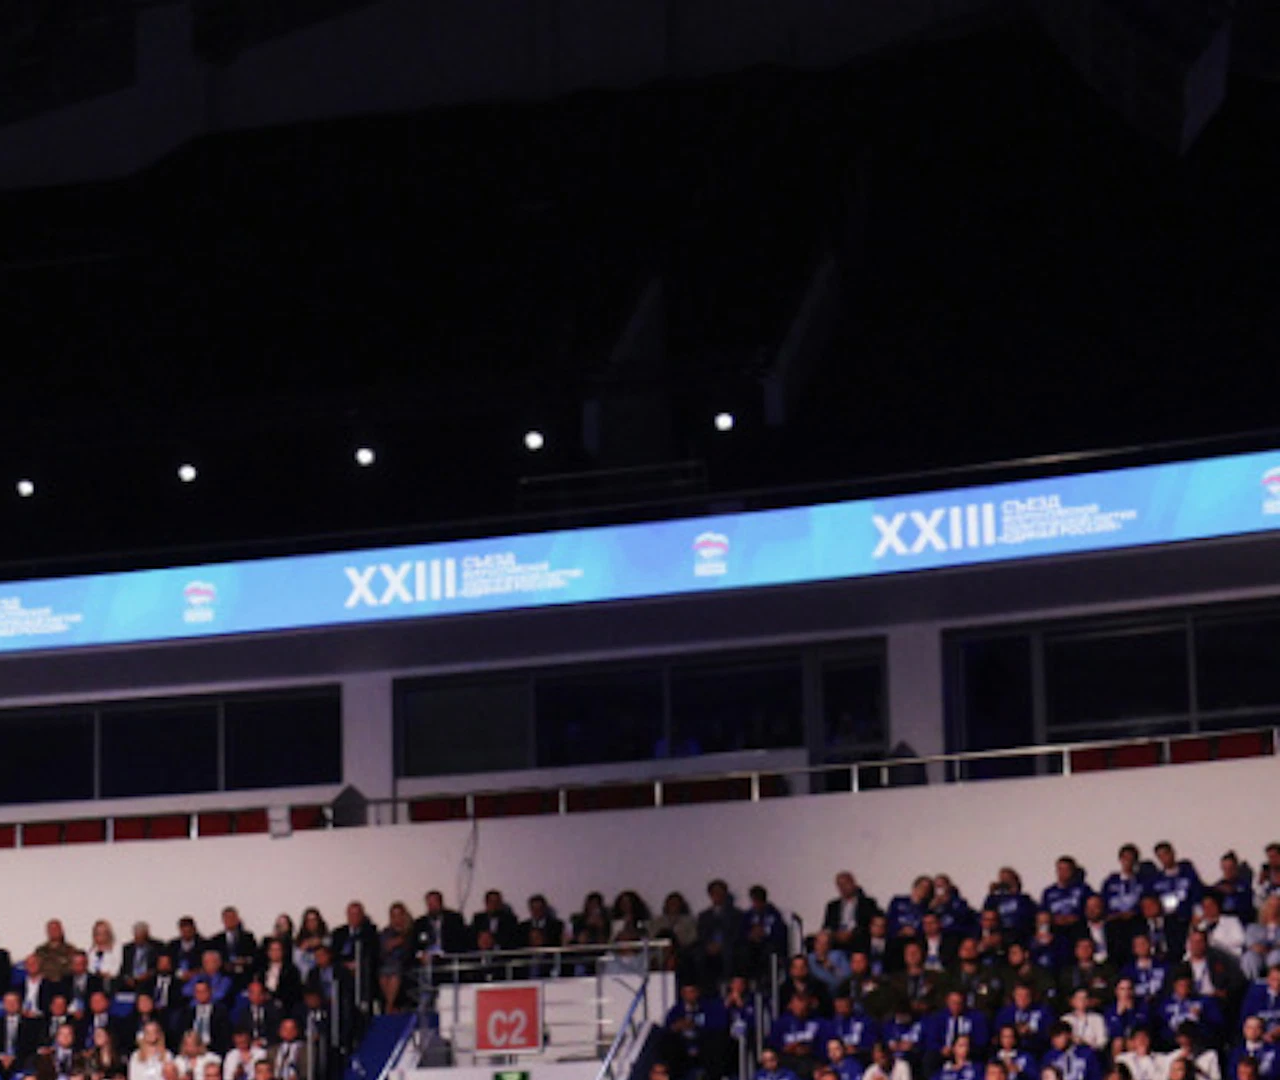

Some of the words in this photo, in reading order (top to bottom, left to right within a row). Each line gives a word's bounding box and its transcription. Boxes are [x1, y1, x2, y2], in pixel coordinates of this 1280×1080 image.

[871, 502, 997, 558] XXIII
[343, 557, 458, 609] XXIII
[487, 1008, 528, 1046] C2
